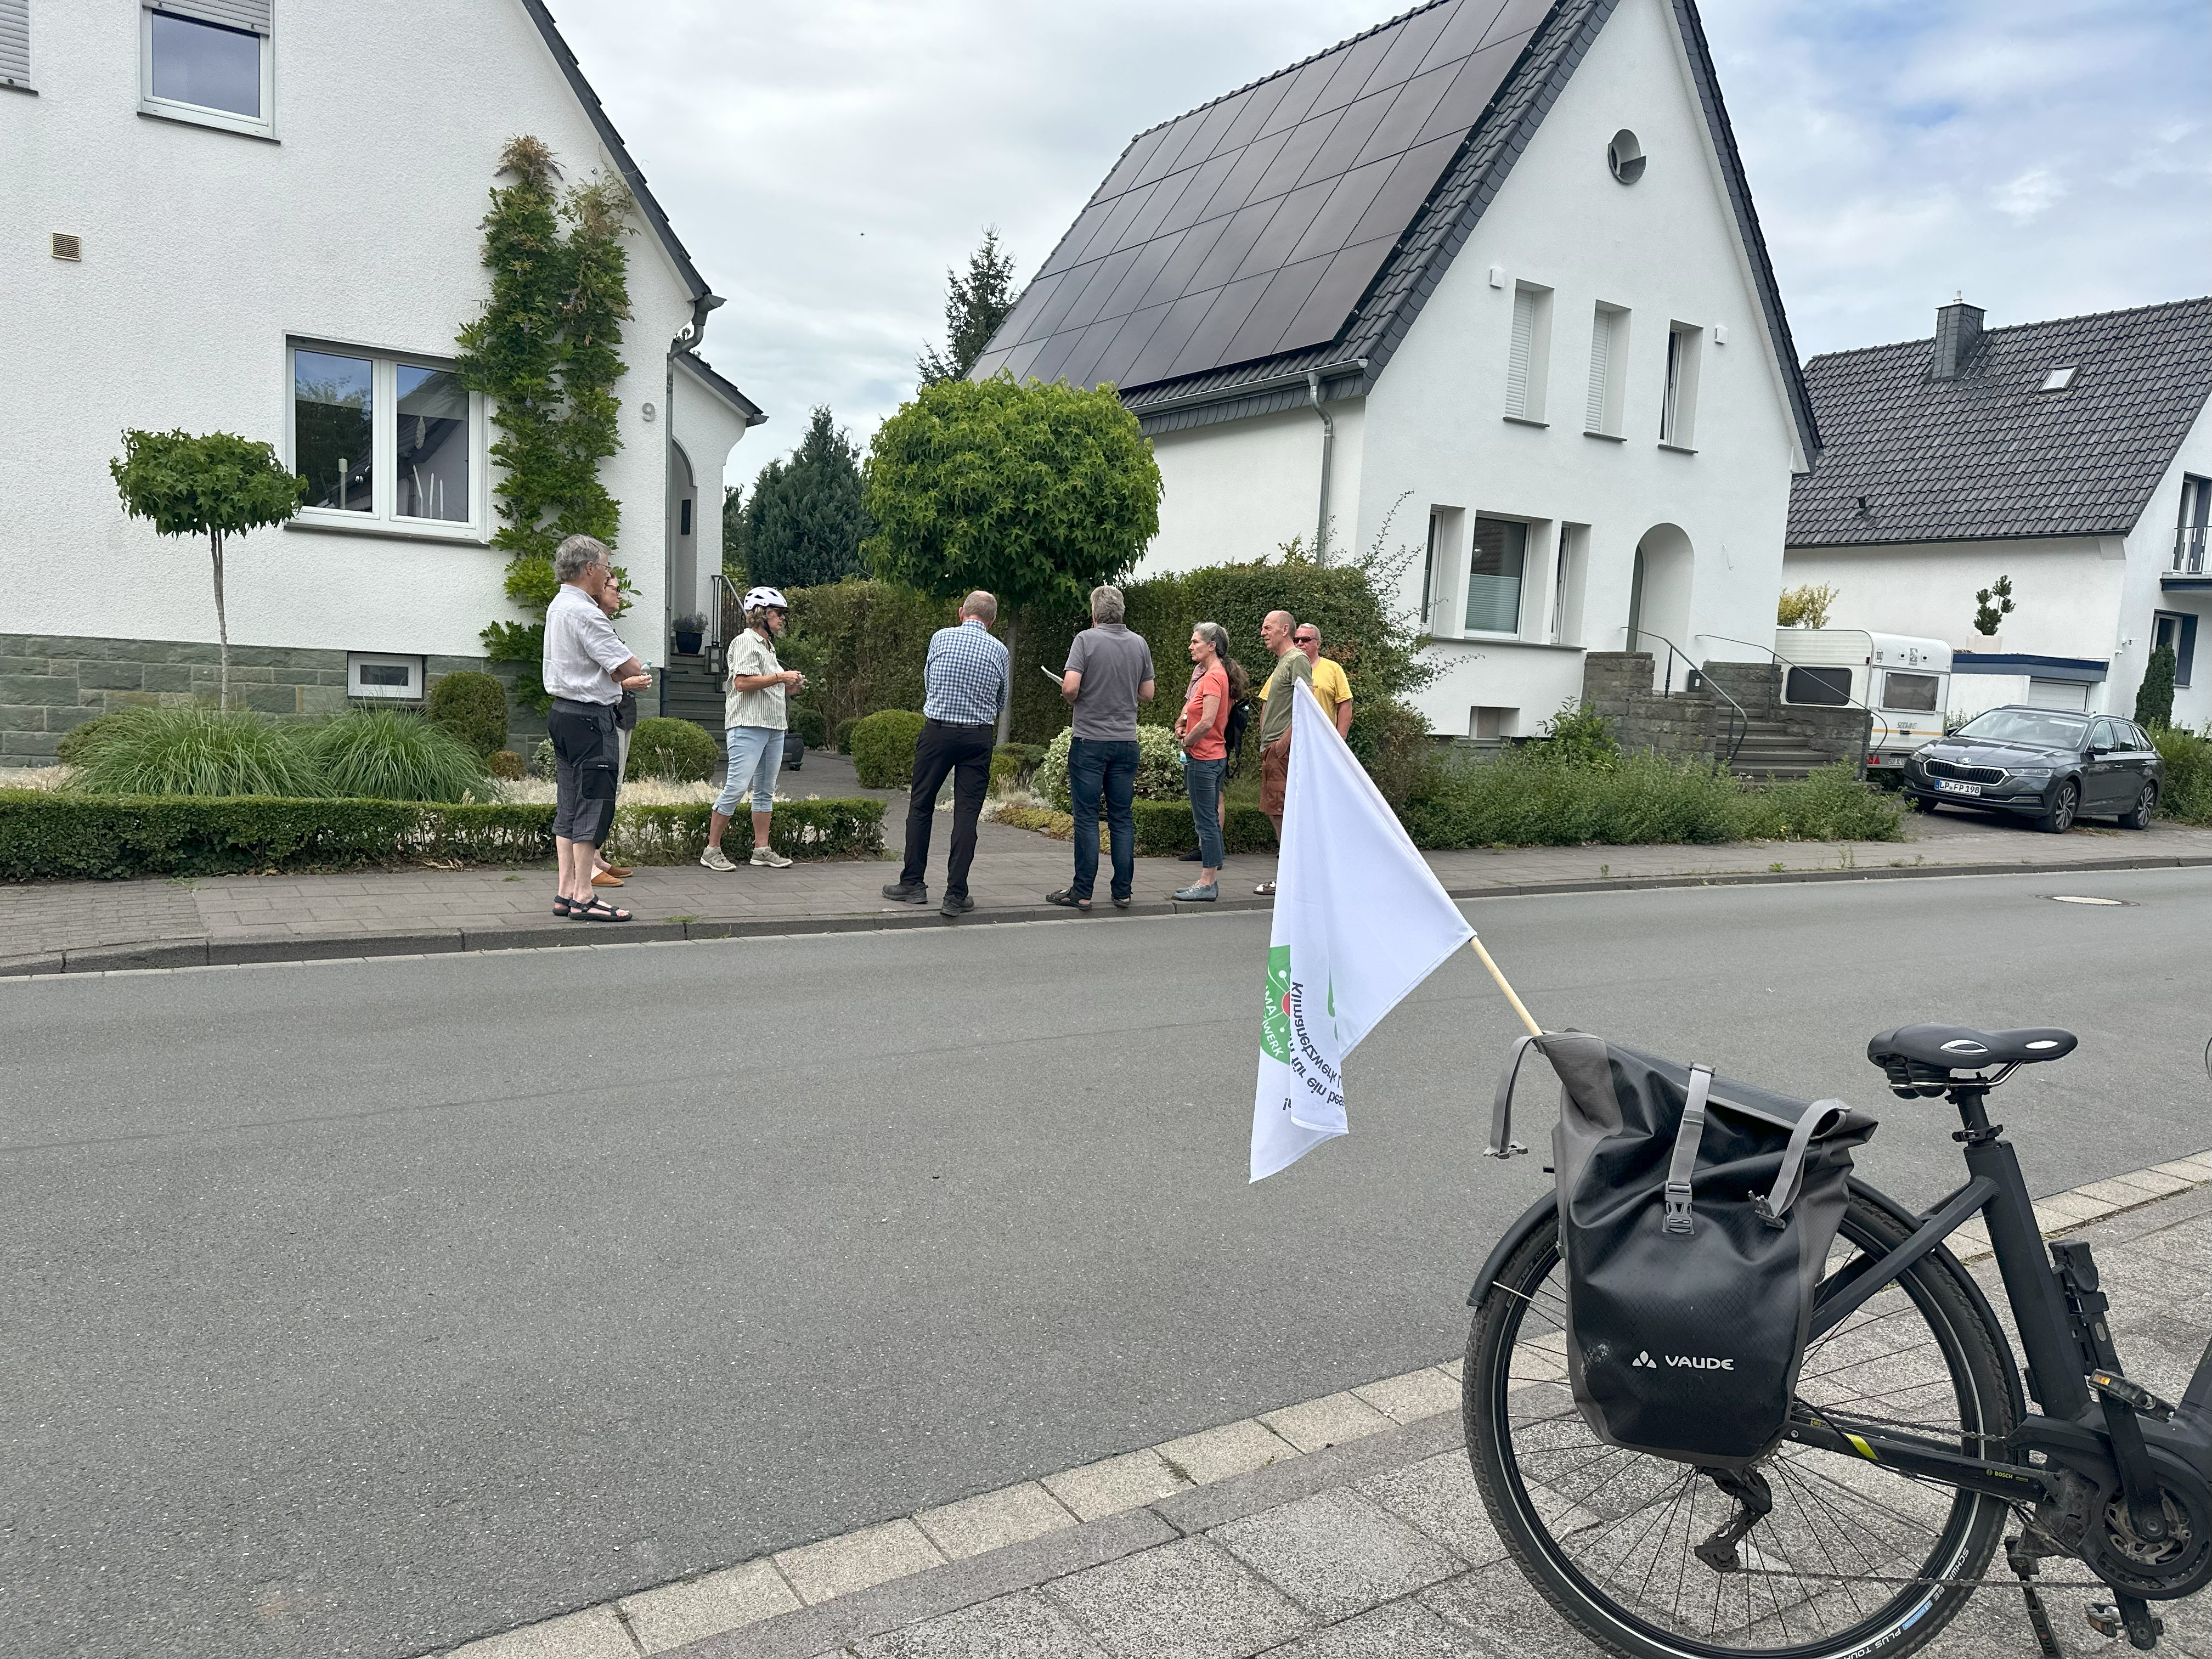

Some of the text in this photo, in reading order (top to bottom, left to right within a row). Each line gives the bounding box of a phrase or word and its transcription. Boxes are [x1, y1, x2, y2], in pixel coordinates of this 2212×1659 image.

[642, 402, 655, 422] 9
[1965, 786, 1980, 794] 198
[1263, 1021, 1284, 1057] WERK
[1664, 1355, 1734, 1370] VAUDE
[1994, 1471, 2013, 1480] BOSCH
[1933, 1547, 1970, 1601] SCHWABE
[1875, 1627, 1901, 1649] PLUS
